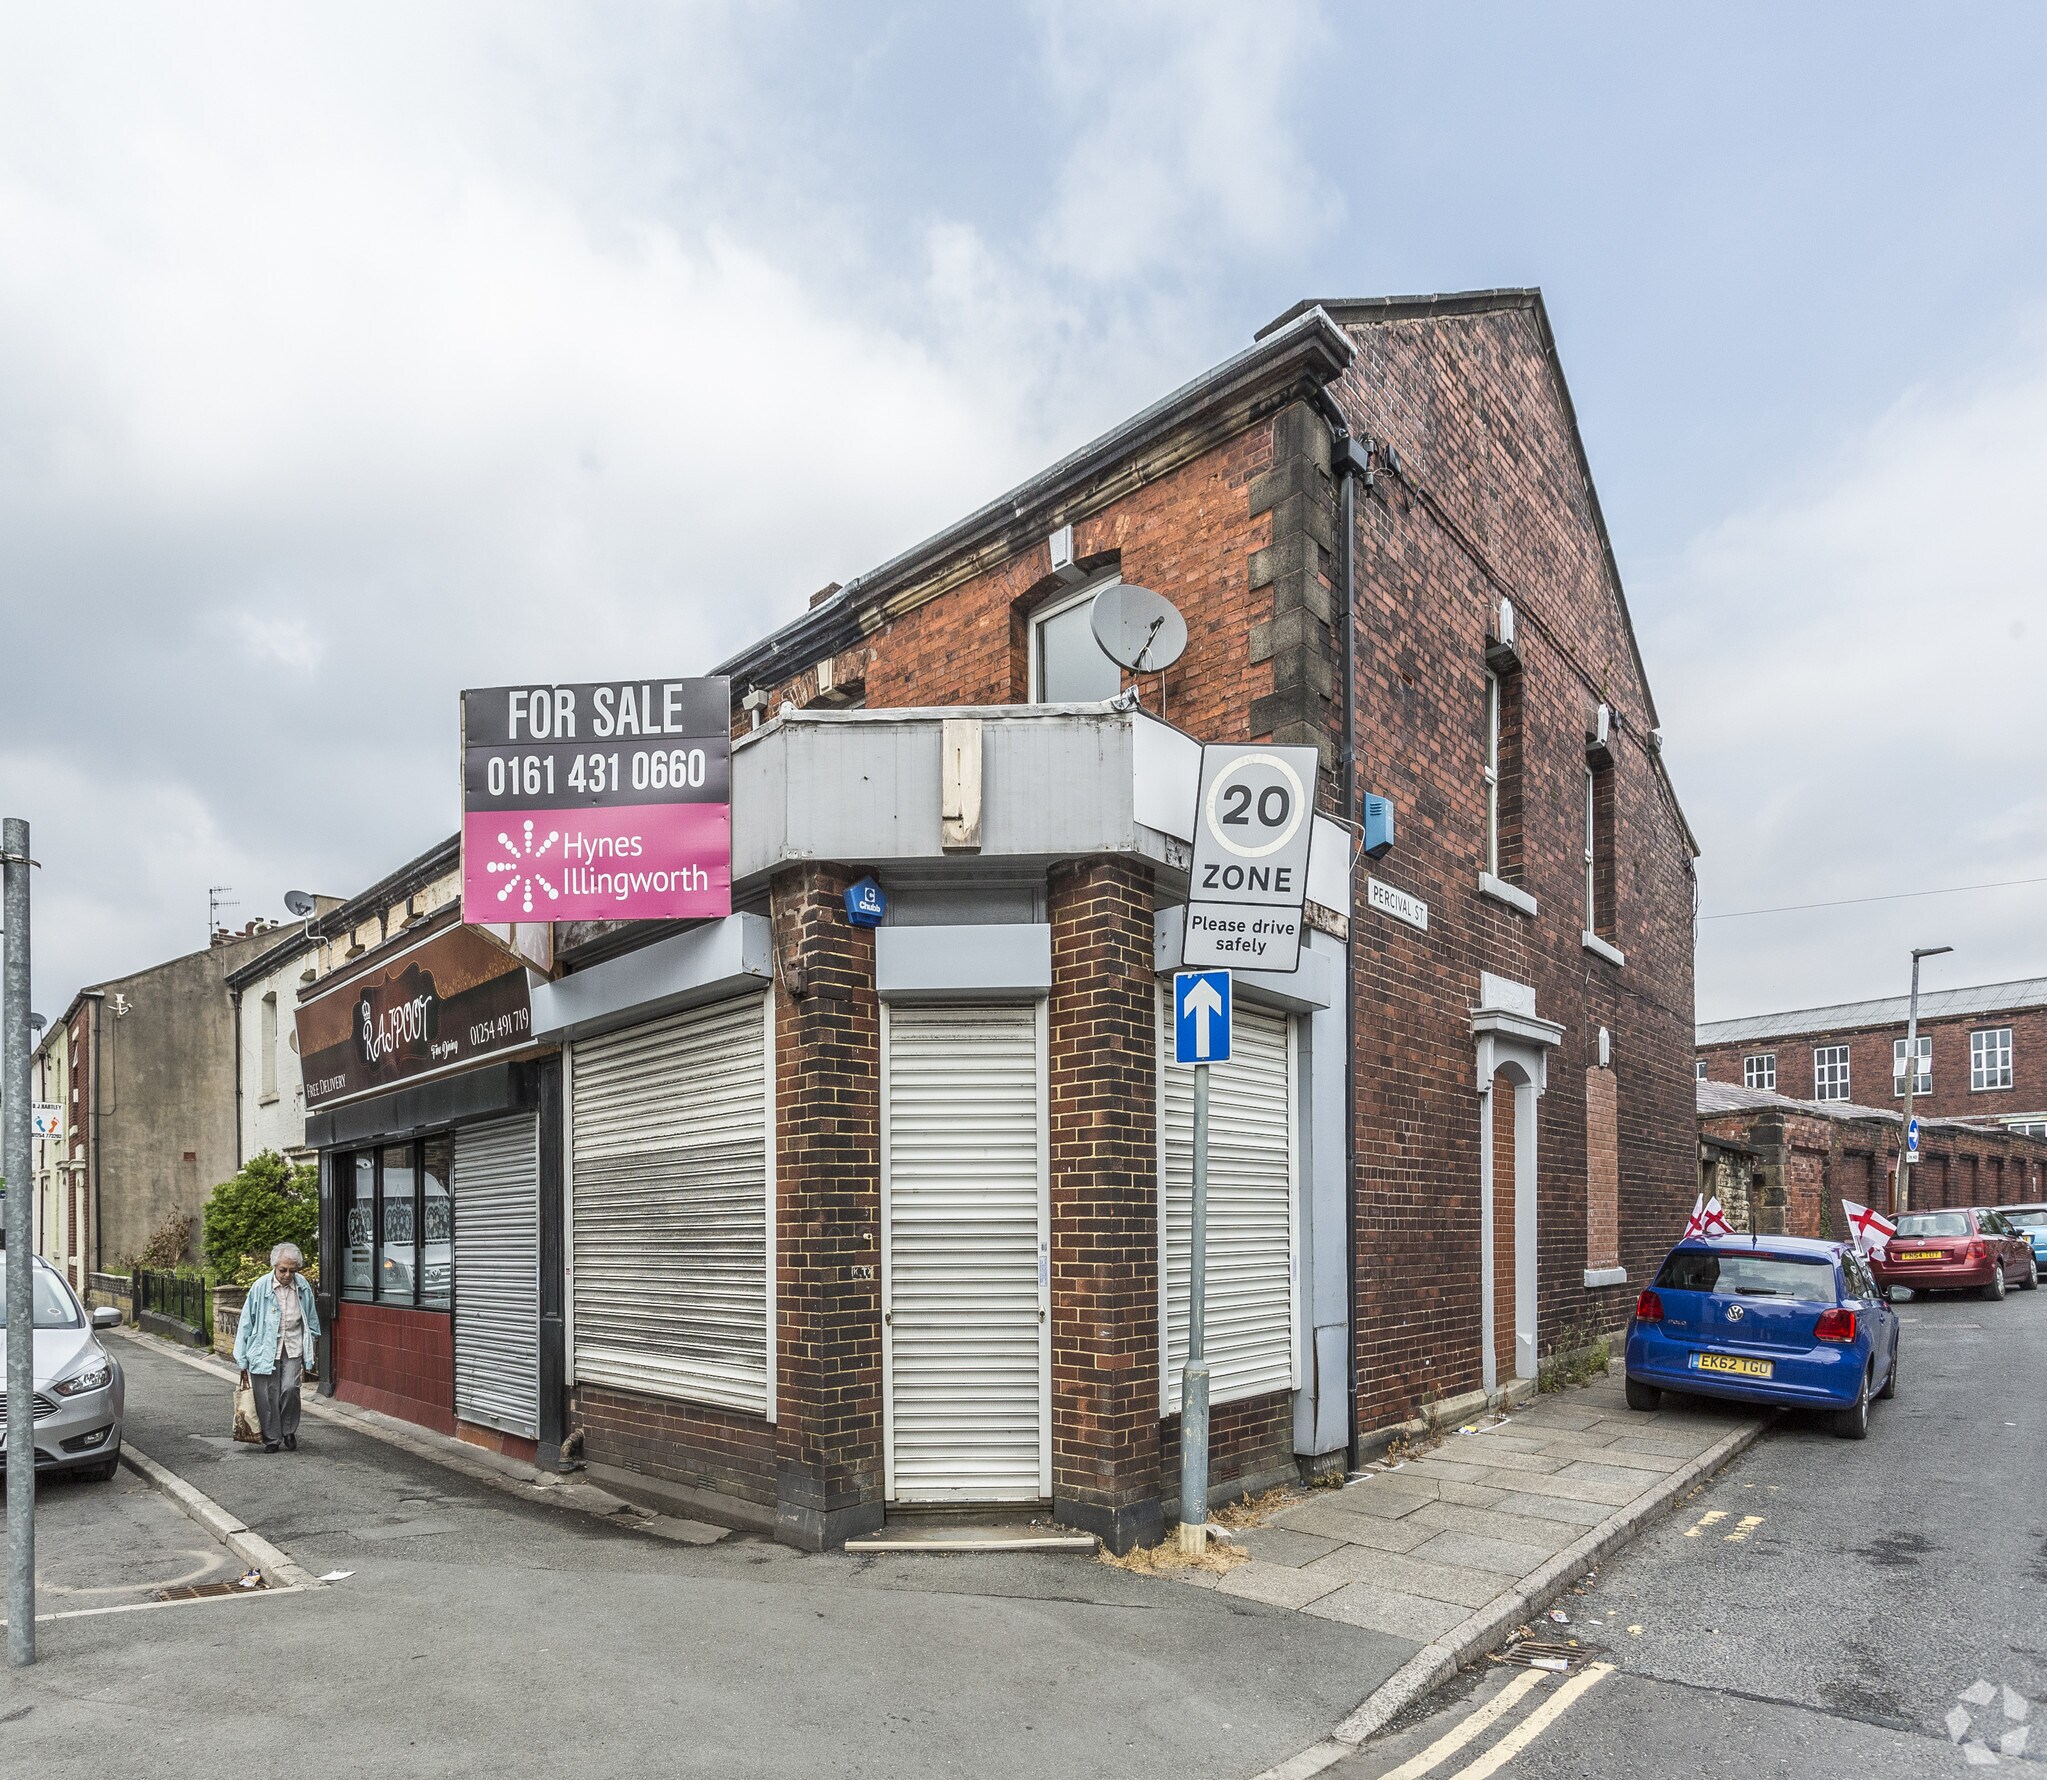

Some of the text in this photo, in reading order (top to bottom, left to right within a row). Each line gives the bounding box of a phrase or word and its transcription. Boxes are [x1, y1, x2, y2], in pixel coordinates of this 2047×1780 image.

[508, 683, 683, 740] FOR SALE
[487, 748, 706, 796] 0161 431 0660
[1222, 784, 1291, 828] 20
[564, 832, 643, 866] Hynes
[564, 863, 708, 900] Illingworth
[1202, 863, 1292, 893] ZONE
[859, 900, 881, 913] Chubb
[1373, 885, 1424, 923] PERCIVAL ST
[1191, 915, 1295, 935] Please drive
[1215, 937, 1267, 956] safely
[362, 994, 432, 1063] RAJPOOT
[470, 1007, 529, 1046] 01254 491 719
[1701, 1355, 1768, 1374] EK62 TGU
